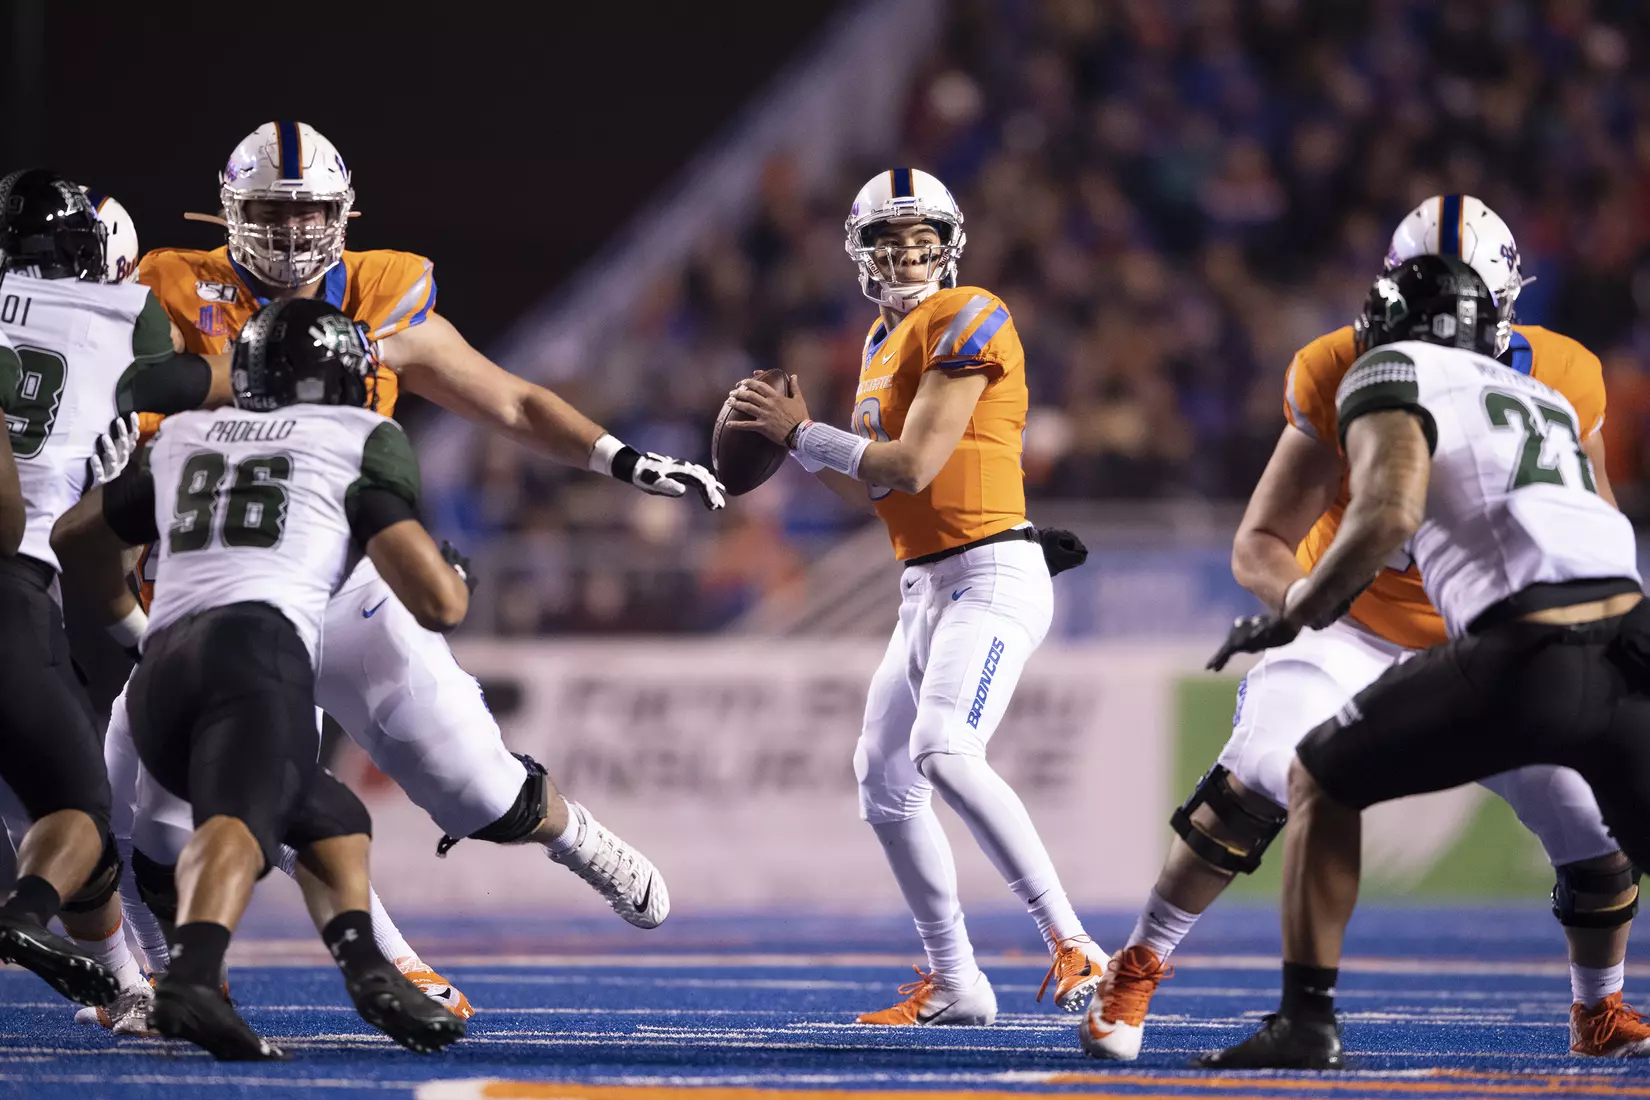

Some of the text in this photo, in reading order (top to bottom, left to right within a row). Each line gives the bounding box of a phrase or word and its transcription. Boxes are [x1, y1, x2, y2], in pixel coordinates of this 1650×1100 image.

[205, 420, 297, 443] PADELLO
[1479, 385, 1598, 494] 27
[167, 448, 295, 558] 96
[965, 635, 1005, 730] BRONCOS
